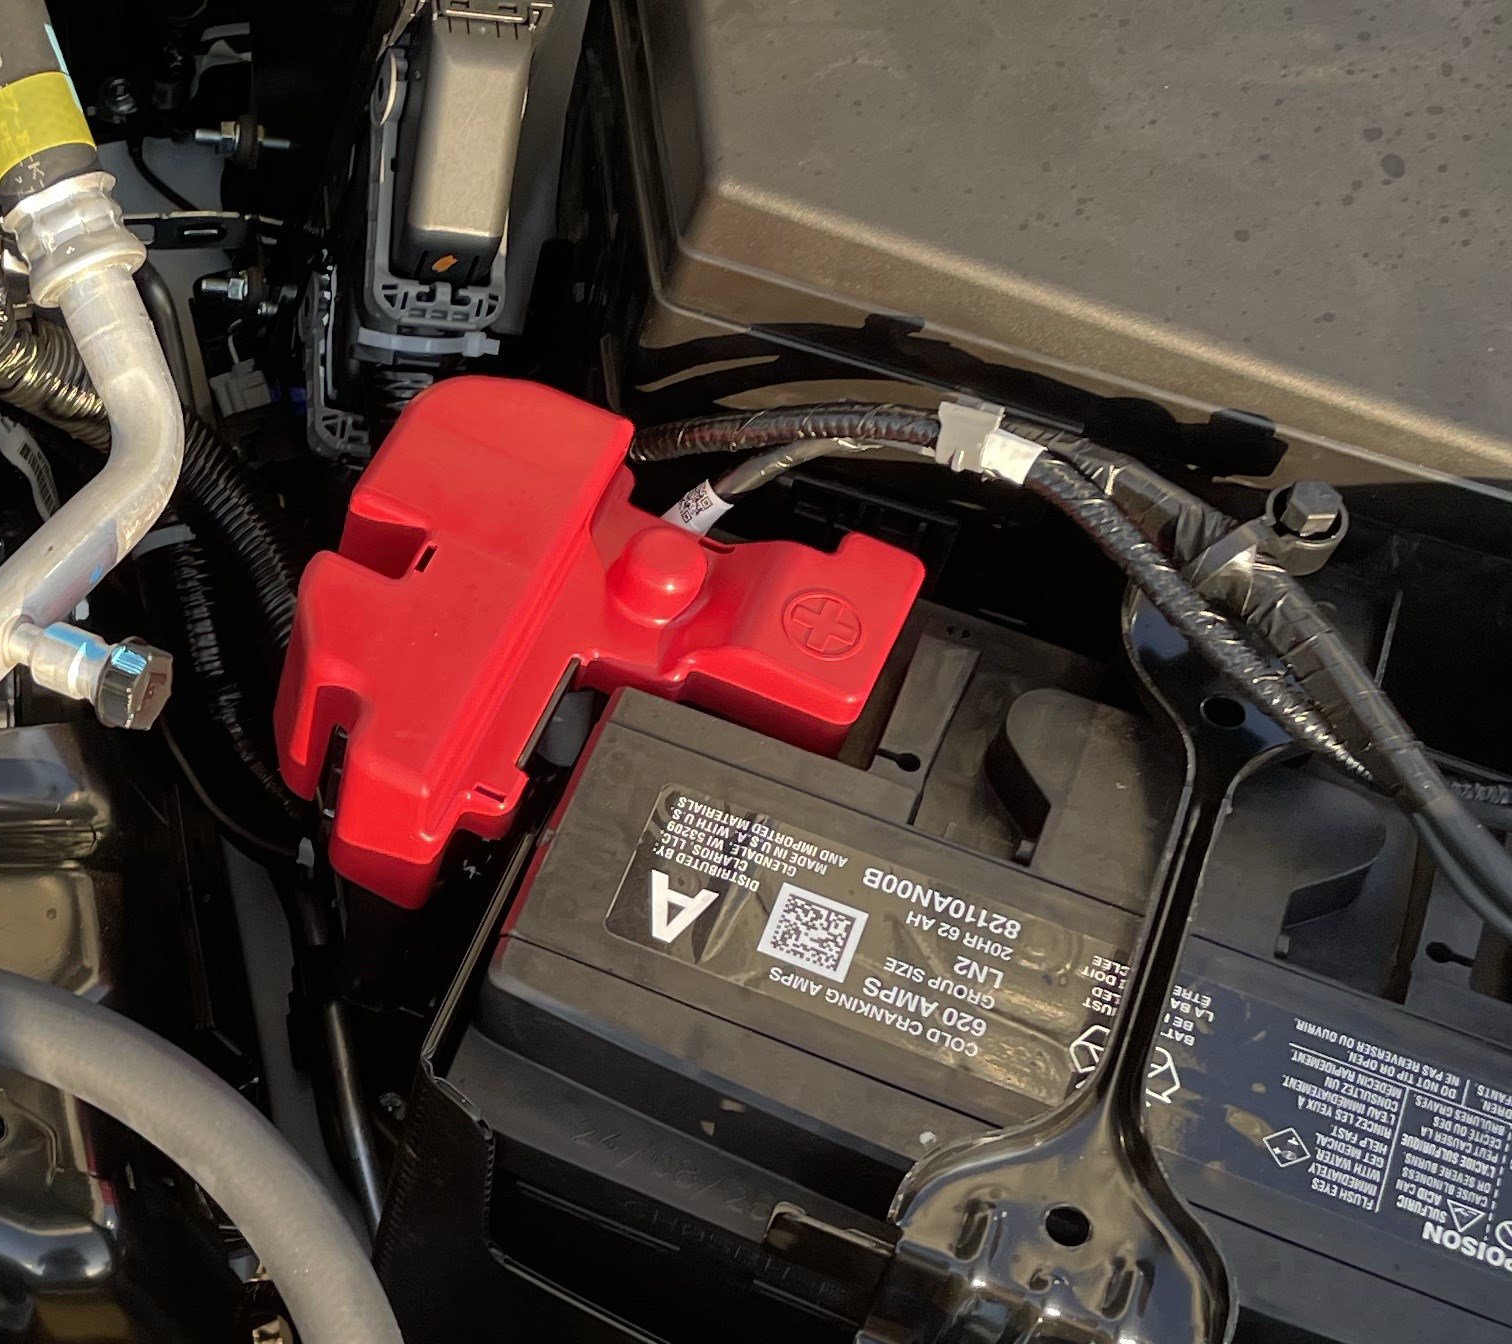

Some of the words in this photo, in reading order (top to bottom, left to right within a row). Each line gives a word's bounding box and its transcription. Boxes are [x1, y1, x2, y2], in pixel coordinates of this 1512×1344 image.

[671, 807, 694, 825] U.S.
[678, 797, 750, 830] MATERIALS
[667, 821, 706, 843] 53209
[696, 818, 729, 838] WITH
[706, 836, 724, 850] WI
[735, 831, 772, 854] U.S.A.
[752, 823, 817, 857] IMPORTED
[653, 843, 674, 859] BY:
[690, 839, 748, 871] CLARIOS,
[773, 847, 788, 859] IN
[820, 850, 848, 867] AND
[676, 853, 759, 892] DISTRIBUTED
[789, 852, 827, 875] MADE
[652, 870, 719, 943] A
[863, 868, 1021, 939] 82110AN00B
[906, 911, 935, 930] AH
[938, 923, 960, 940] 62
[963, 932, 1013, 960] 20HR
[883, 957, 925, 982] SIZE
[954, 956, 1003, 988] LN2
[1080, 966, 1116, 986] DOIT
[769, 967, 822, 995] AMPS
[863, 977, 938, 1017] AMPS
[928, 977, 995, 1009] GROUP
[1173, 985, 1211, 1008] ÊTRE
[825, 988, 922, 1035] CRANKING
[1195, 1007, 1213, 1022] LA
[941, 1008, 986, 1036] 620
[1173, 1016, 1194, 1031] BE
[927, 1028, 980, 1057] COLD
[1339, 1035, 1354, 1048] OU
[1357, 1041, 1420, 1072] RENVERSER
[1380, 1063, 1395, 1076] OR
[1397, 1071, 1413, 1084] TIP
[1422, 1065, 1443, 1081] PAS
[1445, 1073, 1460, 1086] NE
[1324, 1077, 1340, 1090] UN
[1416, 1077, 1439, 1092] NOT
[1441, 1086, 1457, 1099] DO
[1341, 1083, 1398, 1112] CONSULTEZ
[1414, 1094, 1453, 1117] GRAVES.
[1306, 1099, 1332, 1117] YEUX
[1335, 1109, 1354, 1124] LES
[1367, 1107, 1395, 1125] L'EAU
[1355, 1116, 1392, 1139] RINCEZ
[1421, 1126, 1433, 1139] LA
[1433, 1117, 1452, 1131] DES
[1453, 1124, 1467, 1136] OU
[1331, 1126, 1358, 1143] FAST.
[1434, 1132, 1472, 1153] CAUSER
[1316, 1133, 1362, 1159] MEDICAL
[1359, 1138, 1388, 1155] HELP
[1401, 1133, 1459, 1164] SULFURIQUE
[1473, 1146, 1498, 1163] PEUT
[1315, 1147, 1351, 1171] WATER.
[1362, 1153, 1384, 1168] GET
[1403, 1152, 1438, 1173] BURNS.
[1459, 1155, 1496, 1178] L'ACIDE
[1308, 1163, 1377, 1196] IMMEDIATELY
[1353, 1163, 1380, 1182] WITH
[1402, 1167, 1455, 1195] BLINDNESS
[1439, 1166, 1475, 1188] SEVERE
[1312, 1178, 1338, 1196] EYES
[1395, 1179, 1416, 1195] CAN
[1417, 1187, 1442, 1205] ACID
[1477, 1180, 1491, 1193] OR
[1339, 1188, 1373, 1210] FLUSH
[1456, 1187, 1488, 1207] CAUSE
[1397, 1195, 1447, 1223] SULFURIC
